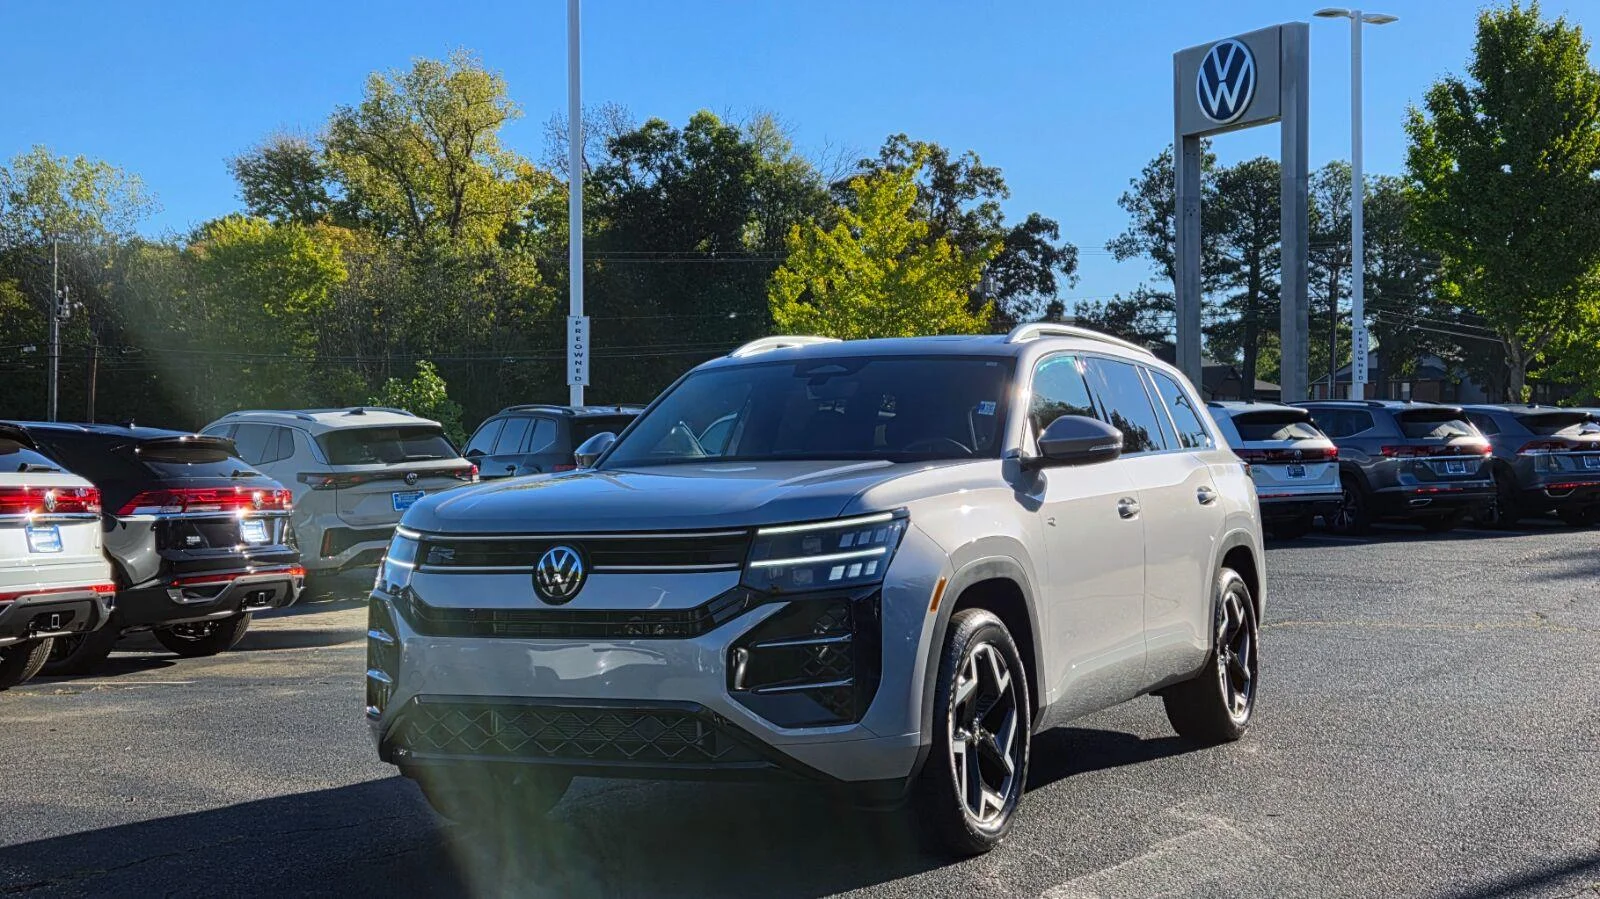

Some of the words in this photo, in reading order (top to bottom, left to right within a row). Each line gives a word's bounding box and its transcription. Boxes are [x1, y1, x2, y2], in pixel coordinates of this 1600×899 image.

[1196, 39, 1256, 124] VW
[574, 320, 584, 382] PREOWNED
[537, 545, 583, 598] VW
